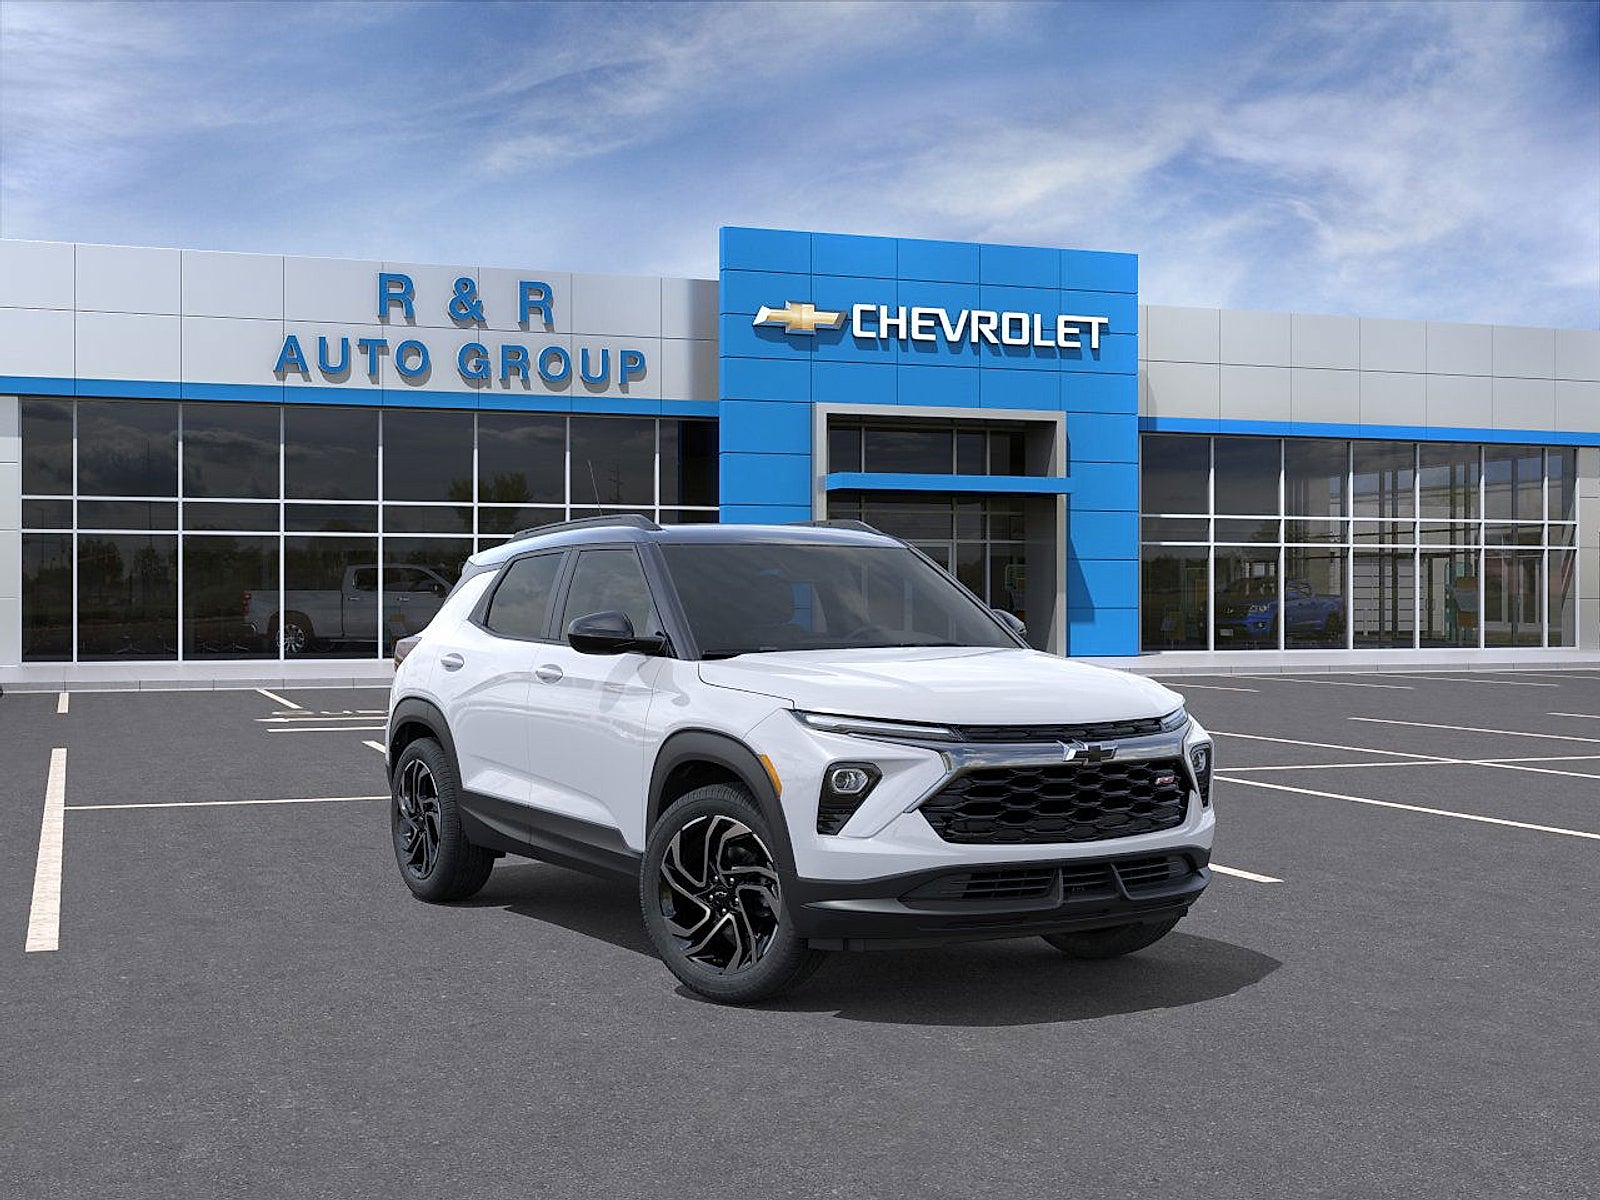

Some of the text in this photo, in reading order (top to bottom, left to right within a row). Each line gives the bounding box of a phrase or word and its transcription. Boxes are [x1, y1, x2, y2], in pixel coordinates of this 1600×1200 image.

[377, 273, 554, 325] R & R
[852, 303, 1109, 349] CHEVROLET
[275, 334, 647, 385] AUTO GROUP
